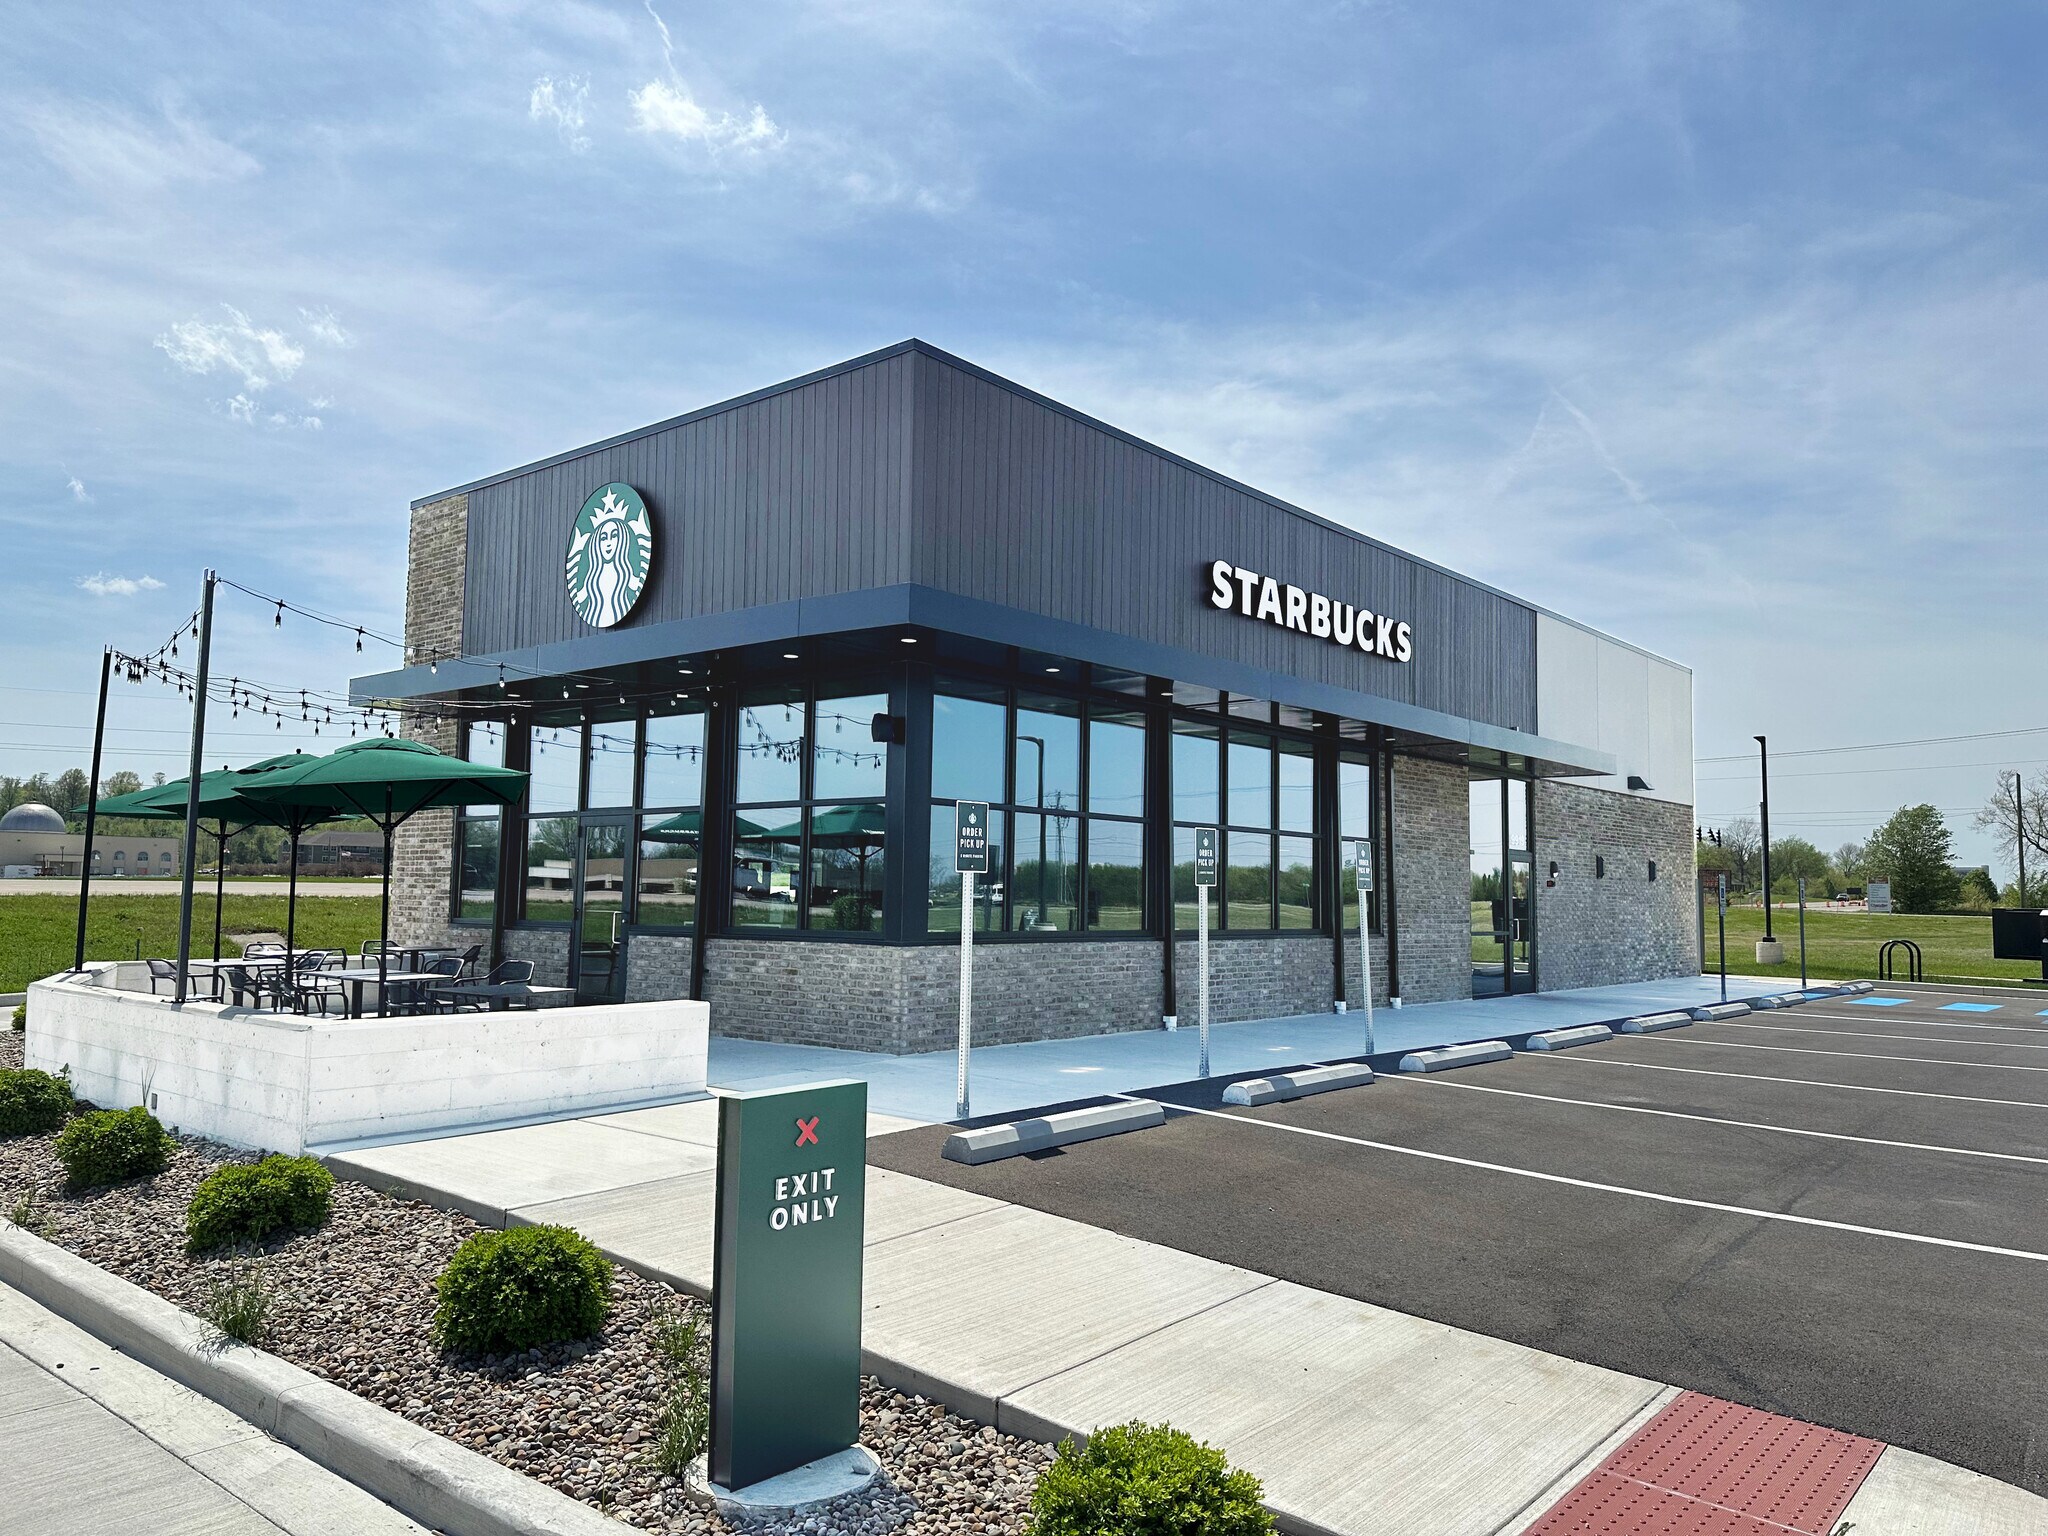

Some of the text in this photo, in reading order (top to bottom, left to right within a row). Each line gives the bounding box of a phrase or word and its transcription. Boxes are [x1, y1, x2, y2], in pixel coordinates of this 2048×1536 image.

[1211, 560, 1412, 663] STARBUCKS
[962, 827, 983, 837] ORDER
[960, 838, 985, 849] PICK UP
[1198, 848, 1213, 857] ORDER
[1197, 858, 1208, 867] PICK
[775, 1168, 835, 1201] EXIT
[769, 1195, 839, 1231] ONLY
